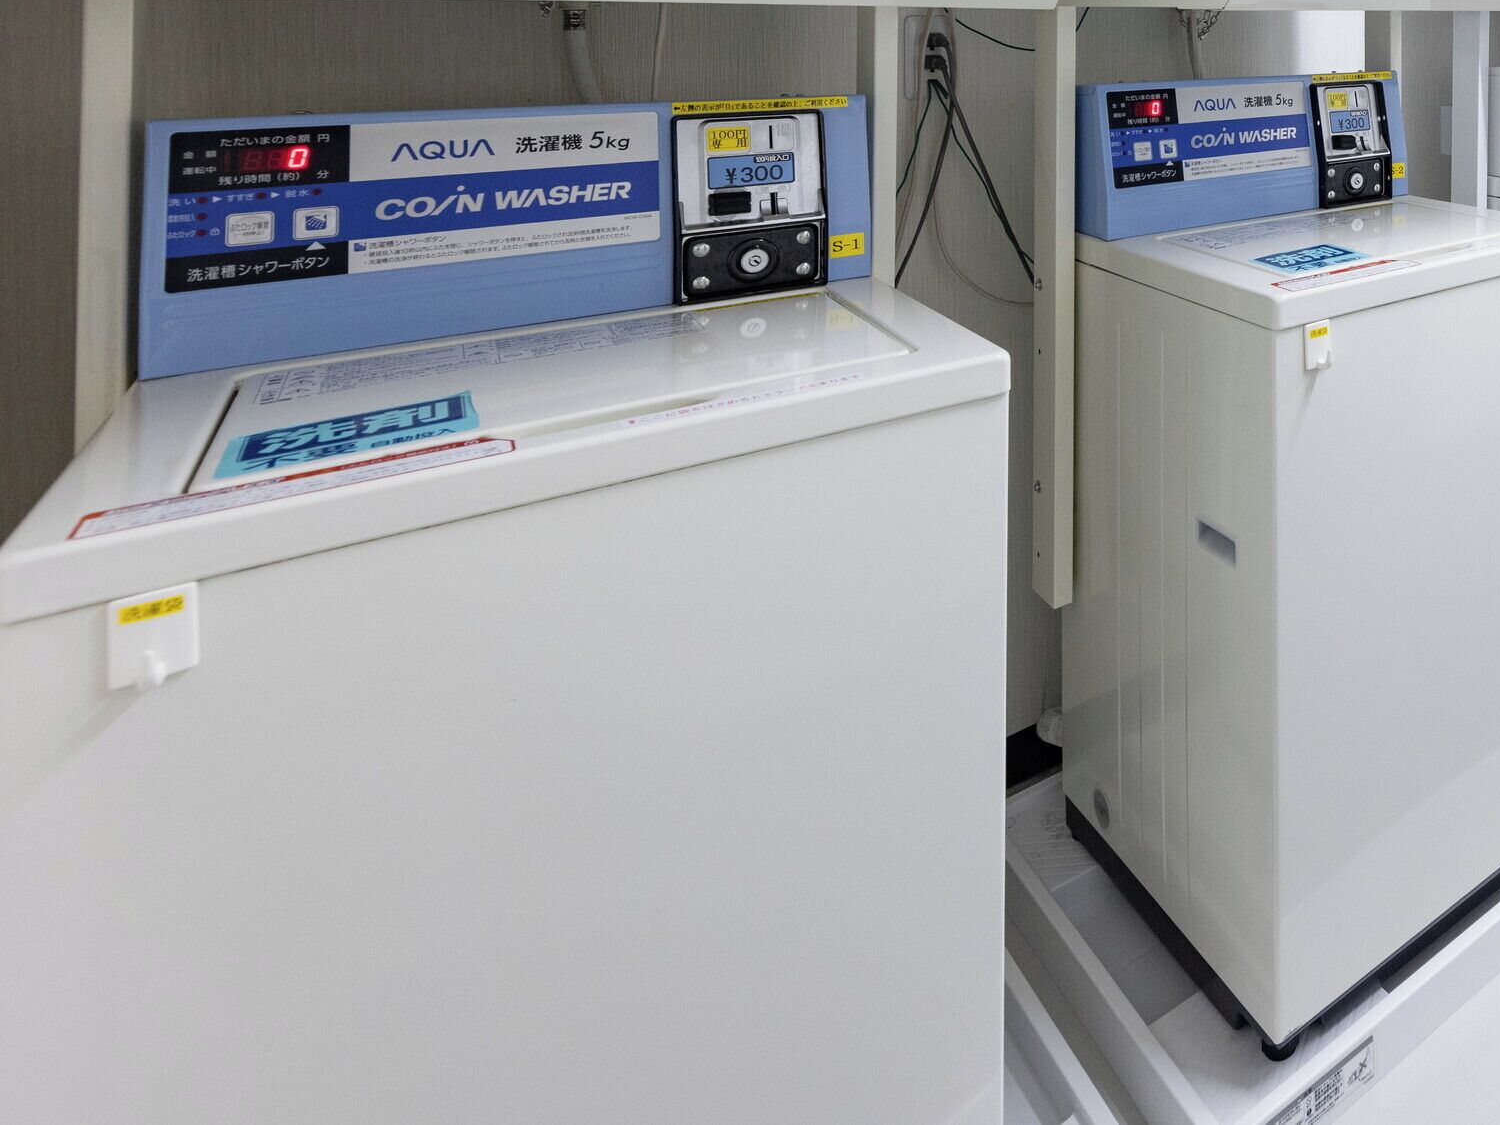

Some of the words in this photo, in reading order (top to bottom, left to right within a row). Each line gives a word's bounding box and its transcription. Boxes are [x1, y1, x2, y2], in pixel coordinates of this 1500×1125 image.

[1194, 98, 1236, 112] AQUA
[1244, 96, 1273, 108] 洗濯機
[1337, 117, 1365, 131] ¥300
[219, 133, 311, 148] ただいまの金額
[317, 133, 330, 143] 円
[1237, 126, 1297, 145] WASHER
[391, 138, 496, 163] AQUA
[514, 133, 582, 154] 洗濯機
[588, 131, 631, 151] 5kg
[288, 148, 308, 168] 0
[725, 164, 784, 185] ¥300
[494, 181, 632, 211] WASHER
[832, 238, 860, 253] S-1
[186, 256, 330, 283] 洗濯槽シャワーボタン
[259, 399, 450, 455] 洗剤
[241, 441, 359, 470] 不要
